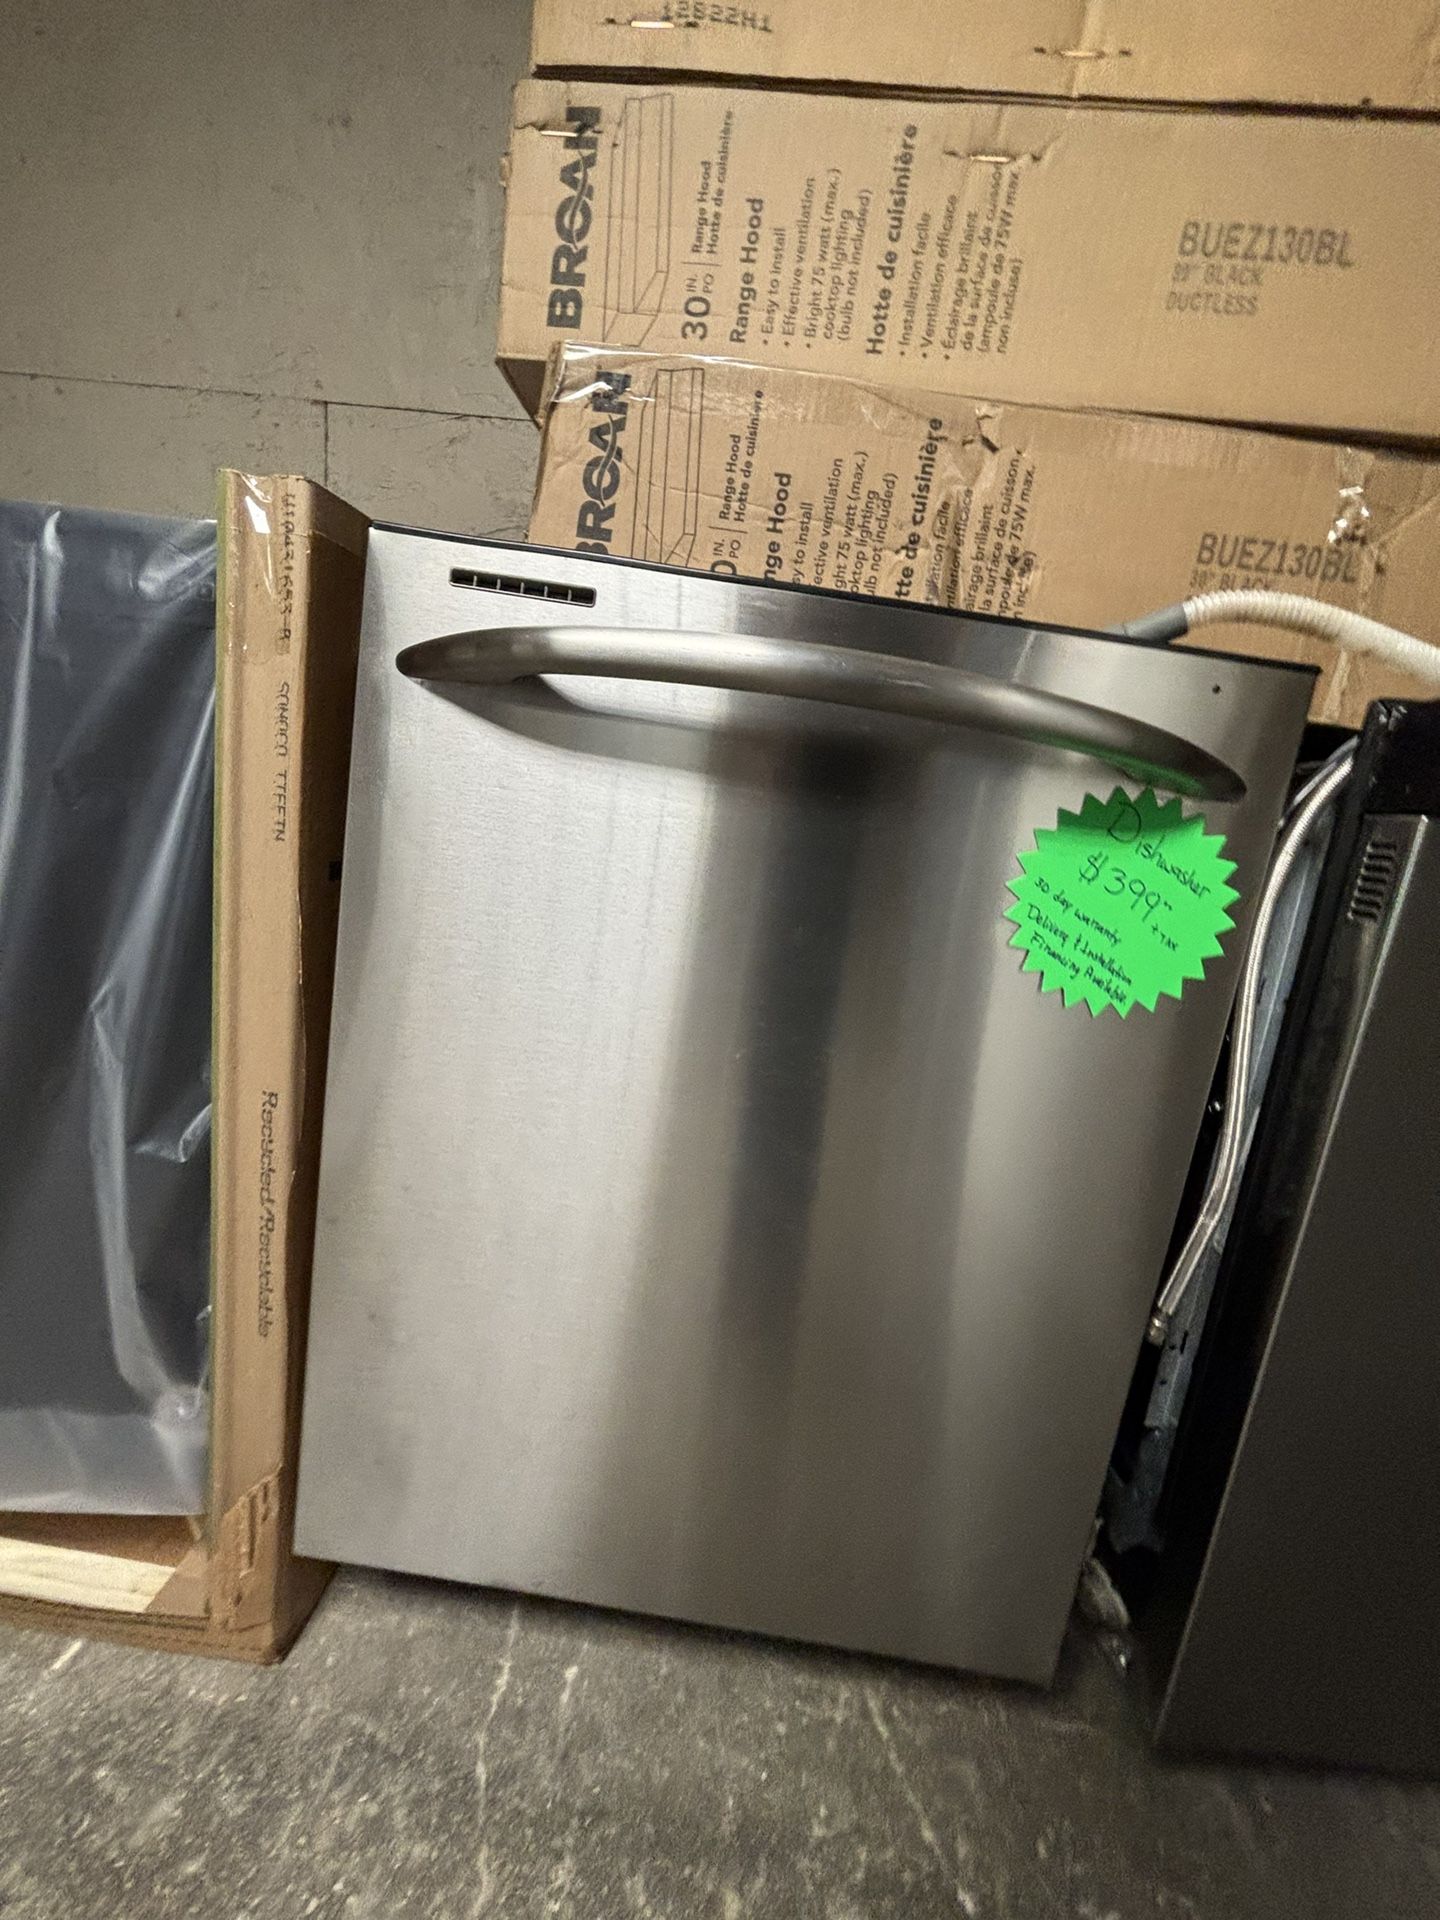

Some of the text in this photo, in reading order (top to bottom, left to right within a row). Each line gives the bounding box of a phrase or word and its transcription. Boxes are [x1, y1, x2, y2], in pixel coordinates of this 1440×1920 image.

[547, 106, 601, 329] BROAN
[691, 160, 712, 253] Range Hood
[708, 218, 721, 256] Hotte
[713, 190, 724, 213] de
[981, 226, 992, 247] de
[729, 197, 764, 343] Range Hood
[782, 177, 816, 336] Effective ventilation
[804, 168, 842, 338] Bright 75 watt (max.)
[823, 208, 854, 340] cooktop lighting
[838, 189, 873, 341] (bulb not included)
[866, 124, 918, 355] Hotte de cuisinière
[920, 194, 957, 347] Ventilation efficace
[993, 253, 1004, 274] de
[1178, 221, 1354, 268] BUEZ130BL
[703, 274, 715, 294] PO
[761, 227, 786, 334] Easy to install
[899, 212, 931, 346] Installation facile
[970, 251, 988, 309] surface
[1165, 291, 1258, 315] DUCTLESS
[681, 296, 711, 341] 30
[963, 329, 974, 351] de
[966, 313, 977, 327] la
[998, 332, 1009, 354] non
[719, 434, 740, 520] Range Hood
[734, 483, 748, 522] Hotte
[741, 456, 752, 479] de
[873, 472, 899, 544] included)
[895, 417, 942, 598] tte de cuisinière
[1009, 507, 1025, 541] 75W
[1020, 465, 1036, 504] max.
[714, 539, 725, 556] IN.
[729, 540, 741, 559] PO
[763, 472, 792, 581] nge Hood
[792, 502, 814, 584] sy to install
[813, 458, 843, 585] ective ventilation
[833, 451, 869, 589] ght 75 watt (max.)
[848, 489, 880, 593] oktop lighting
[934, 500, 950, 541] facile
[979, 457, 1020, 611] la surface de cuisson
[871, 546, 883, 575] not
[965, 556, 982, 611] airage
[1197, 532, 1356, 583] BUEZ130BL
[1107, 801, 1211, 899] Dishwasher
[1028, 903, 1068, 947] Delivery
[1034, 877, 1049, 893] 30
[1053, 890, 1072, 913] day
